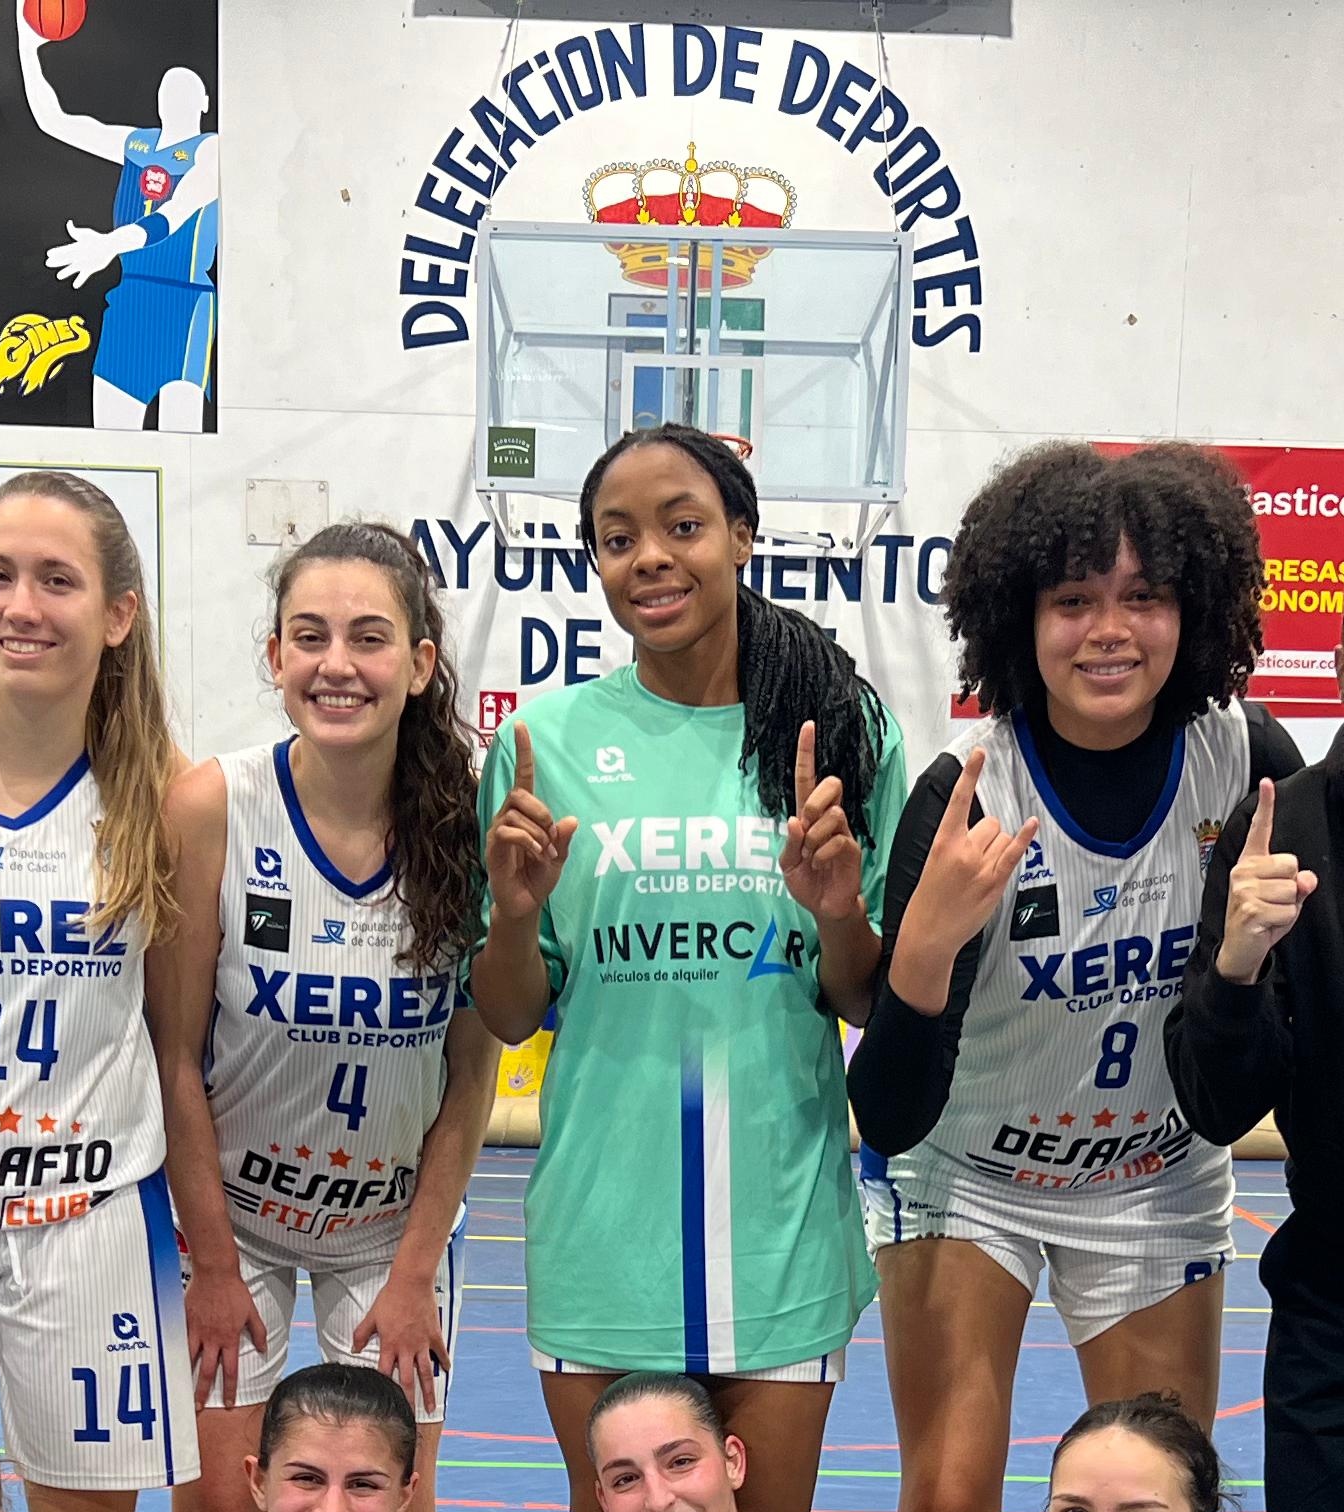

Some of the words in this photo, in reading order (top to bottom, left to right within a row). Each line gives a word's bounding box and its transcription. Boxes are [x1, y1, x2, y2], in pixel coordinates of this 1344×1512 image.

[672, 24, 763, 103] DE
[777, 40, 982, 353] DEPORTES
[520, 616, 602, 686] DE
[9, 847, 67, 862] Diputación
[591, 815, 784, 878] XERE
[10, 862, 24, 873] de
[27, 862, 58, 874] Cádiz
[246, 877, 291, 892] austral
[634, 875, 690, 894] CLUB
[695, 873, 787, 897] DEPORTI
[1121, 893, 1135, 908] de
[351, 921, 403, 935] Diputación
[351, 936, 364, 947] de
[367, 935, 395, 947] Cádiz
[11, 959, 123, 978] DEPORTIVO
[653, 969, 669, 982] de
[672, 969, 719, 984] alquiler
[1018, 924, 1196, 1002] XERE
[245, 963, 451, 1031] XEREZ
[1066, 993, 1114, 1014] CLUB
[1119, 983, 1185, 1005] DEPOR
[287, 1028, 341, 1044] CLUB
[347, 1028, 447, 1049] DEPORTIVO
[1095, 1020, 1139, 1089] 8
[326, 1062, 369, 1132] 4
[6, 1193, 91, 1227] CLUB
[259, 1199, 313, 1230] FIT
[72, 1363, 157, 1444] 14
